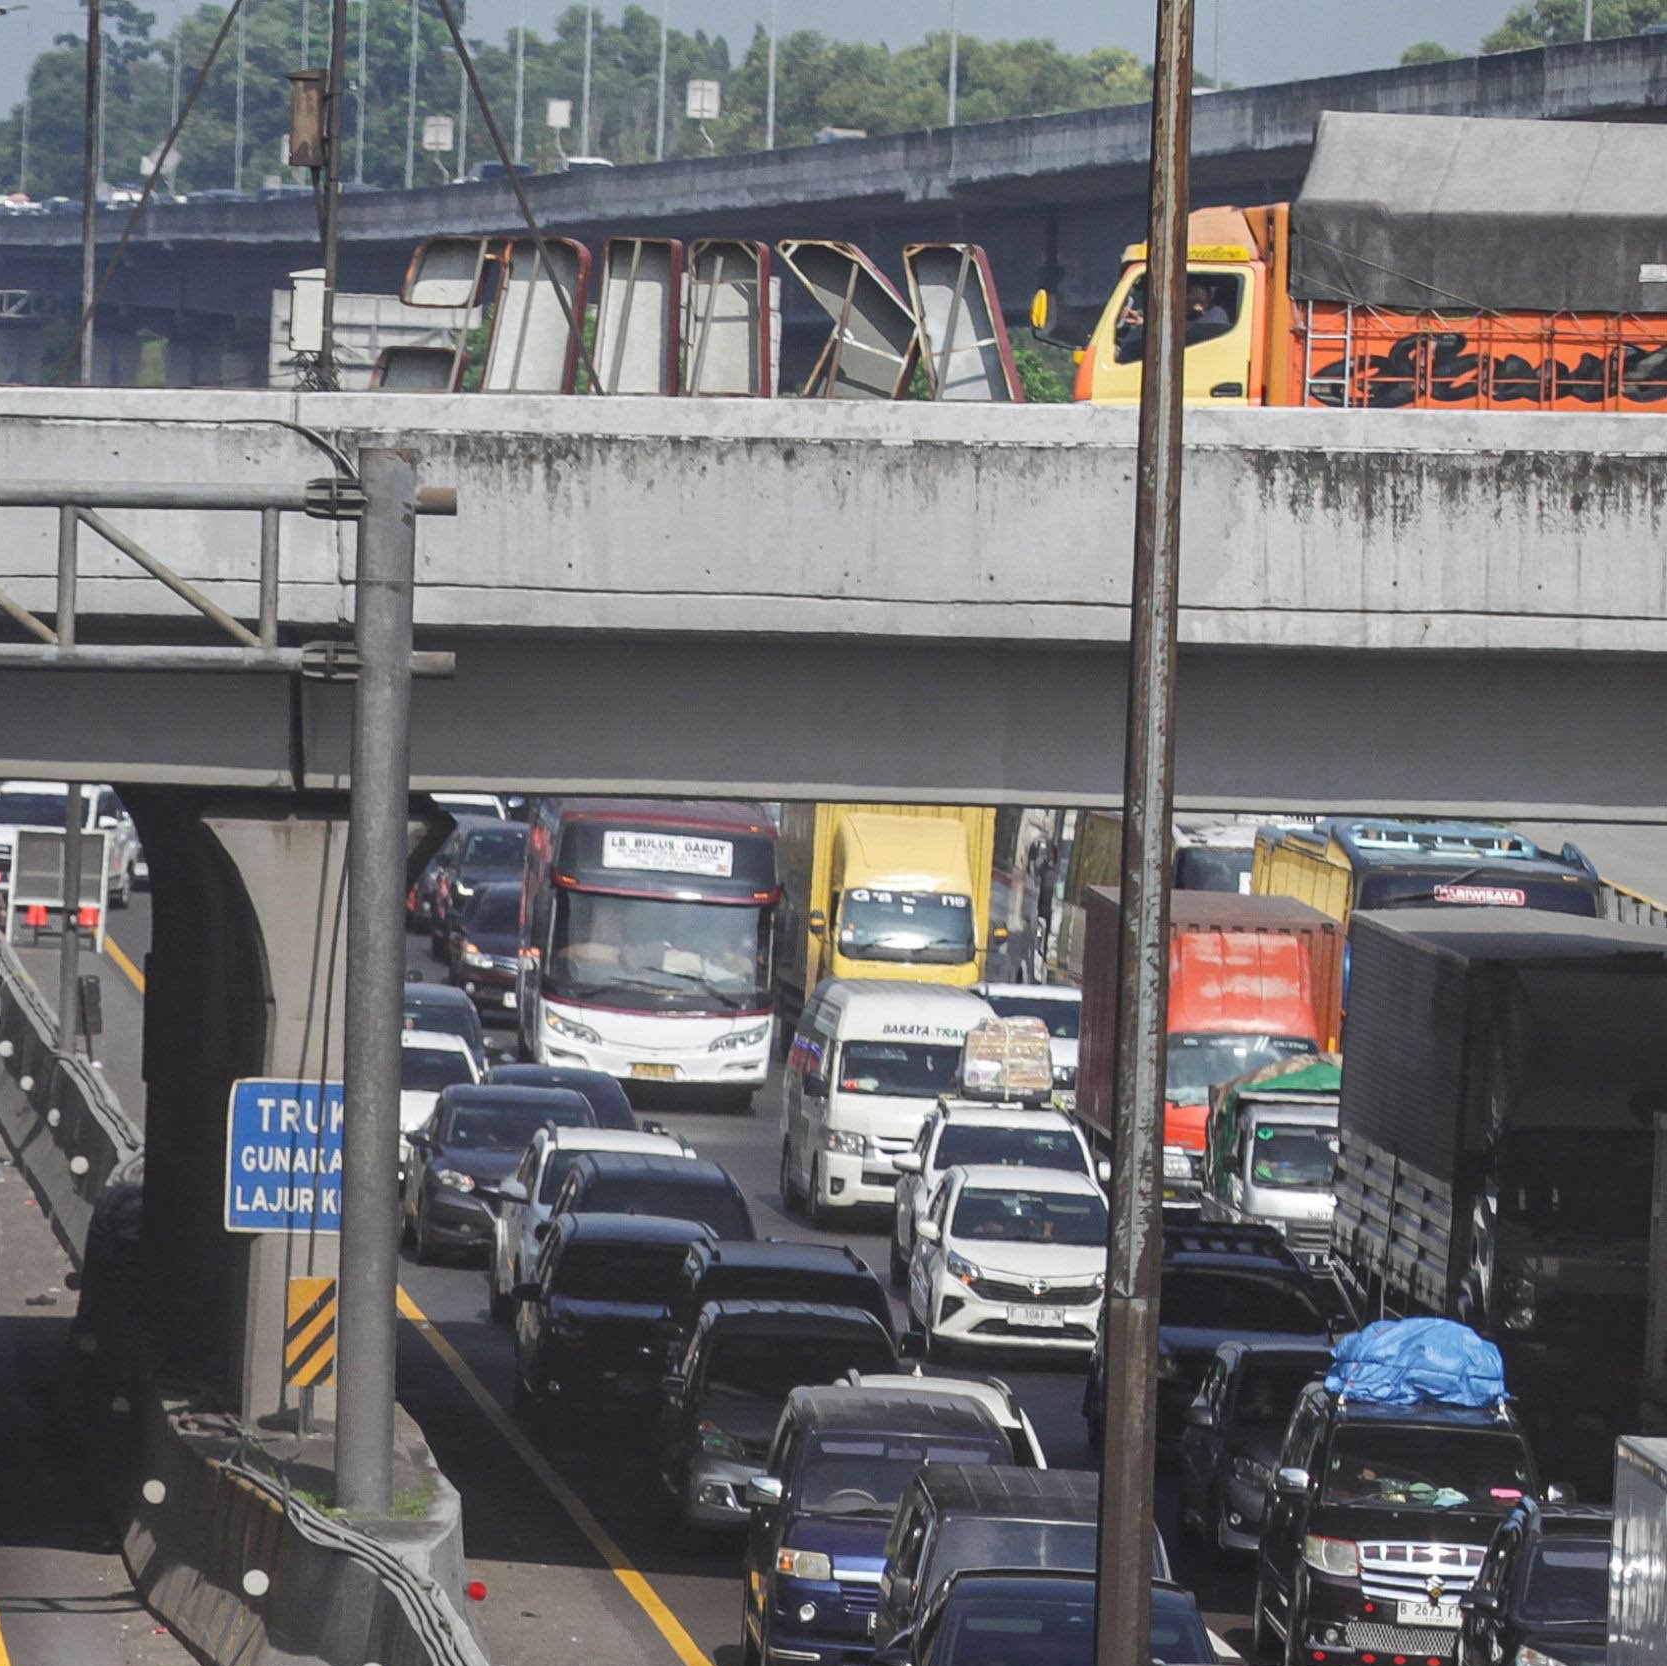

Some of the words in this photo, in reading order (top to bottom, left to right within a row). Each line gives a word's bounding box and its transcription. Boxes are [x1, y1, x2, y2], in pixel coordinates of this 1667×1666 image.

[882, 1024, 929, 1037] BARAYA
[257, 1097, 344, 1134] TRUK
[236, 1184, 314, 1214] LAJUR
[1400, 1603, 1408, 1615] B
